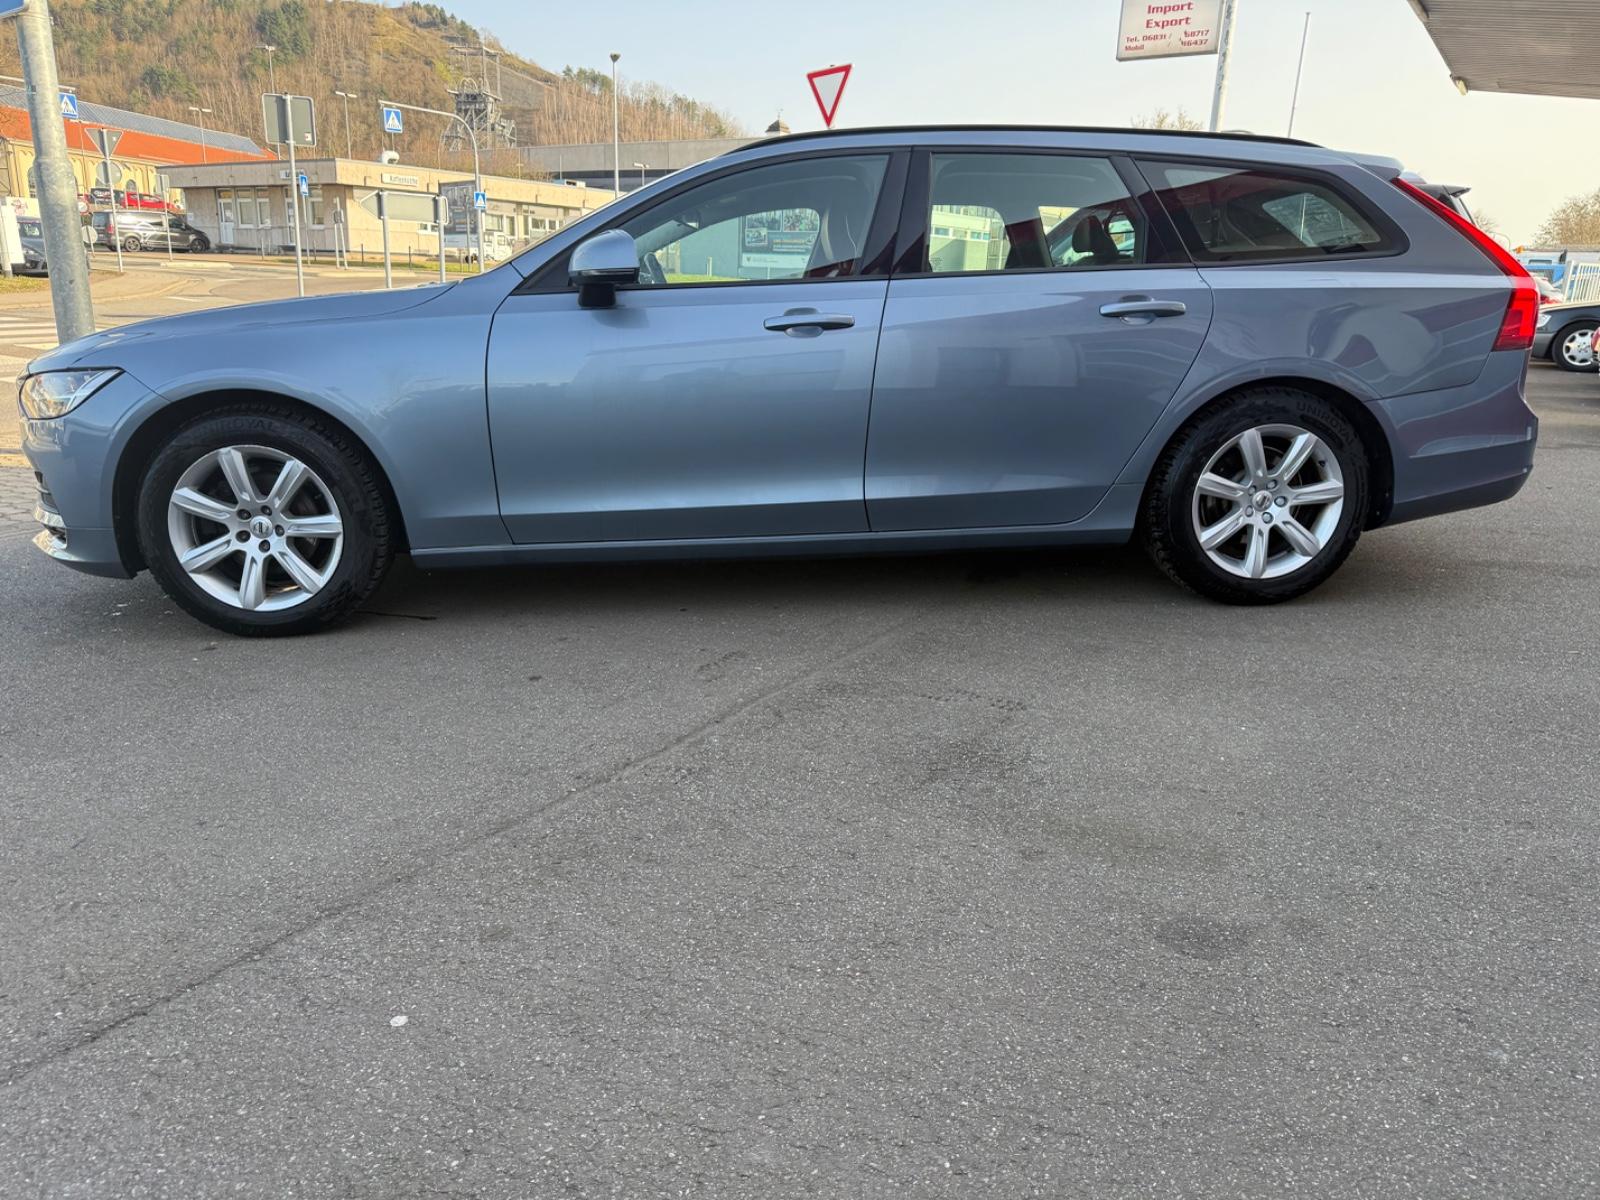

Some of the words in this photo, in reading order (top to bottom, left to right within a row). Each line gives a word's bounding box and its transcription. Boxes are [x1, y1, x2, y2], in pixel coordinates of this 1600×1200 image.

[1147, 2, 1194, 15] Import
[1146, 17, 1192, 29] Export
[1126, 34, 1140, 43] Tel.
